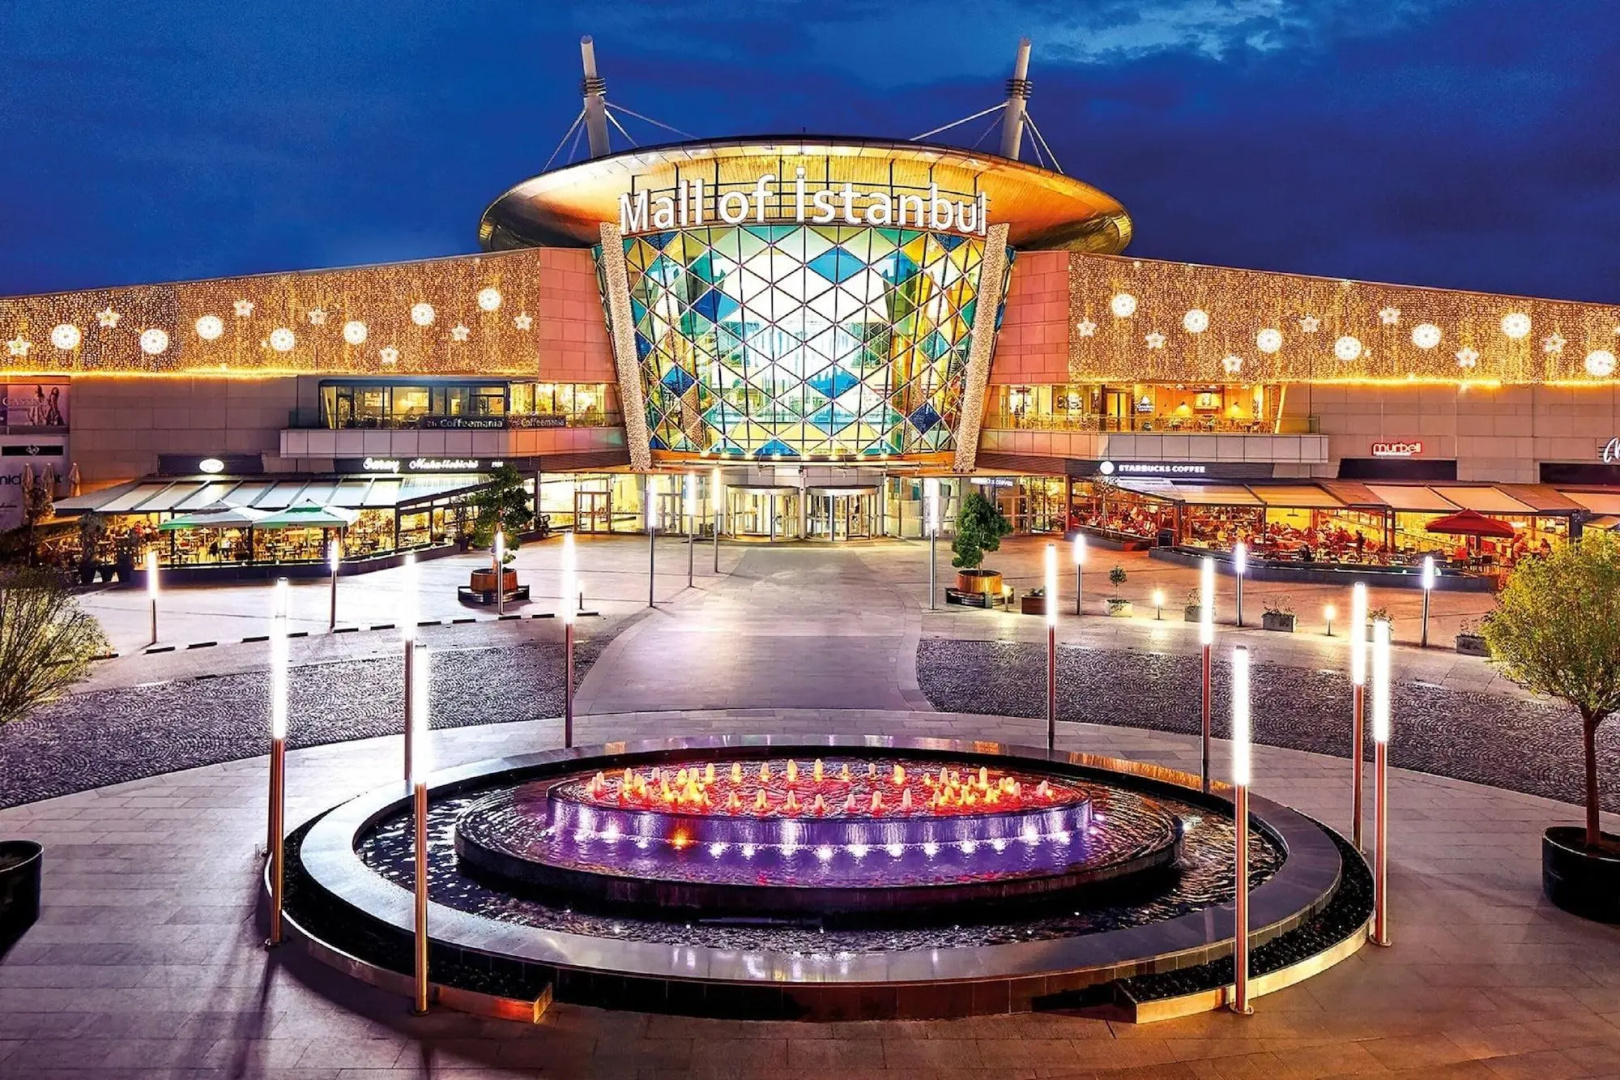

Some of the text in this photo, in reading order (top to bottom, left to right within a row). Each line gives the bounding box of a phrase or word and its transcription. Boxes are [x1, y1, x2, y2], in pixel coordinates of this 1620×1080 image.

[620, 178, 705, 235] Mall
[718, 174, 776, 224] of
[440, 418, 503, 428] Coffeemania
[1118, 464, 1206, 473] STARBUCKS COFFEE
